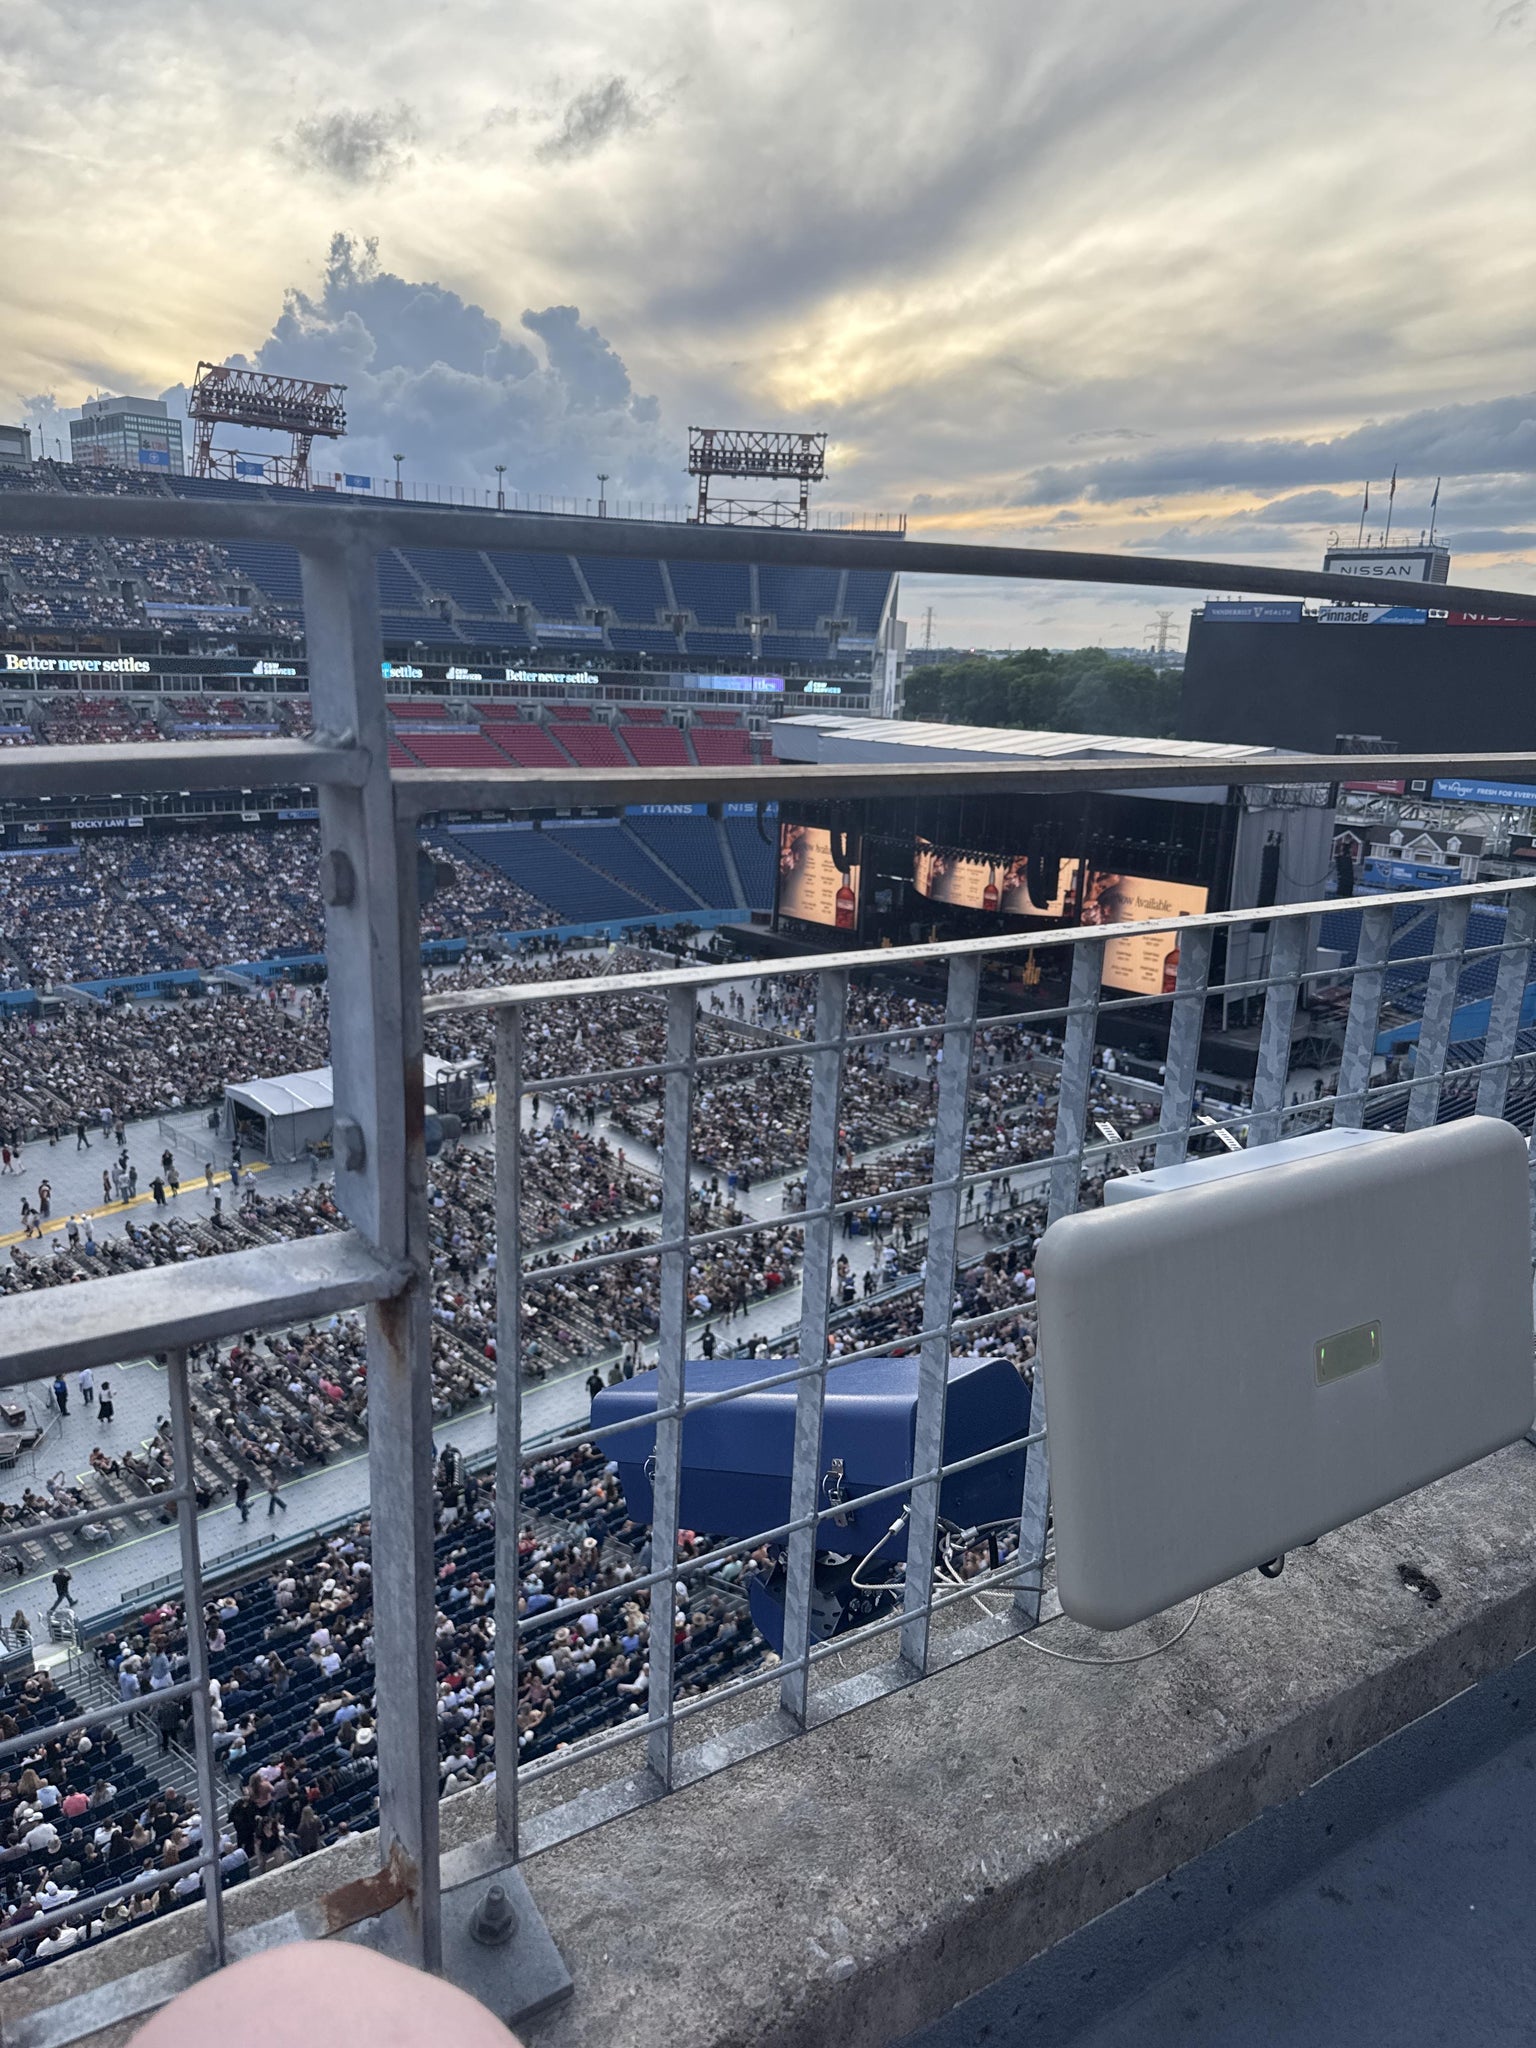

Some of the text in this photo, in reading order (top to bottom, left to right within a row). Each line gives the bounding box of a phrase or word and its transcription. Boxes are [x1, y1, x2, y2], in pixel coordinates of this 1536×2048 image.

[1340, 565, 1411, 576] NISSAN
[1211, 608, 1252, 616] VANDERBILT
[1319, 608, 1369, 622] Pinnacle
[5, 653, 151, 673] Better never settles
[390, 664, 424, 679] settles
[505, 668, 600, 685] Better never settles
[1448, 781, 1474, 797] Kroger
[1476, 788, 1498, 796] FRESH
[1498, 789, 1513, 797] FOR
[640, 804, 693, 814] TITANS
[24, 823, 49, 832] FedEx
[71, 820, 104, 829] ROCKY
[104, 819, 125, 827] LAW
[1135, 896, 1172, 913] Available
